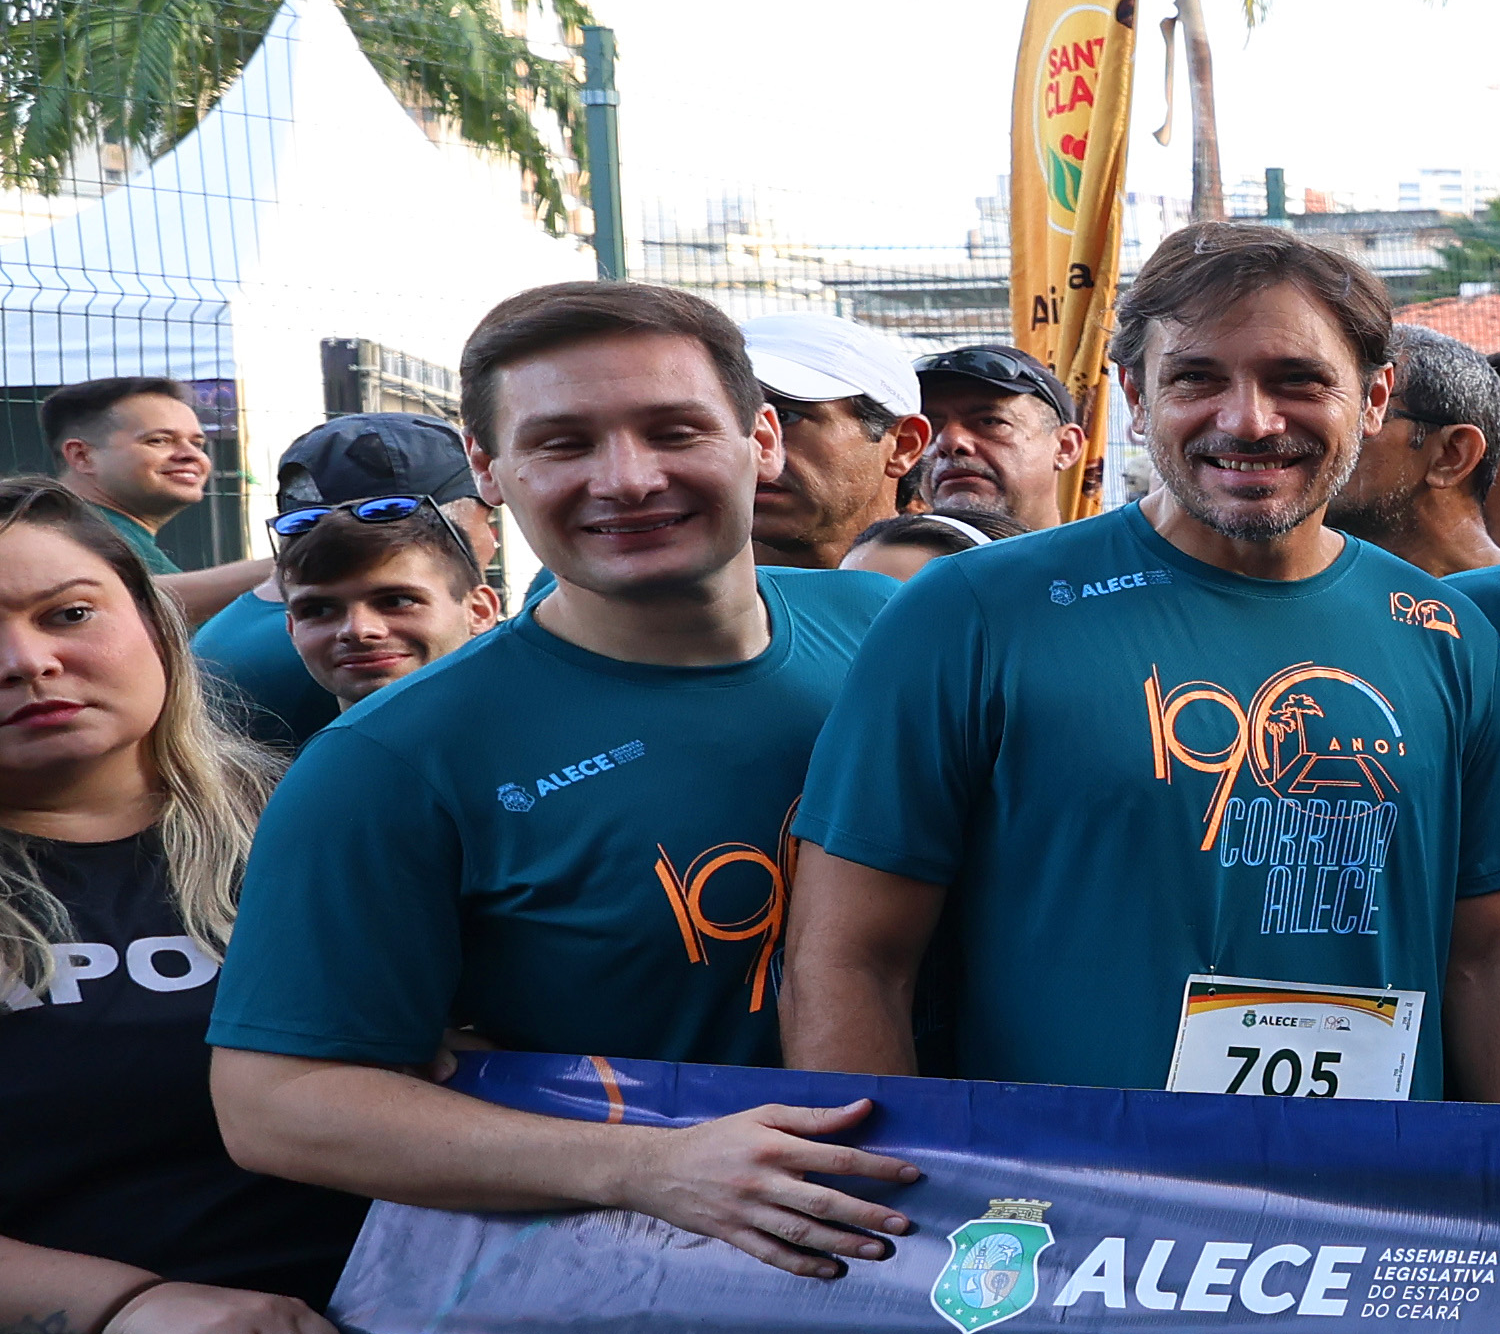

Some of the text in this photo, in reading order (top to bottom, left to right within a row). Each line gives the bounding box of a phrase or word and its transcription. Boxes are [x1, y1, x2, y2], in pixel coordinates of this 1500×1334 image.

[1081, 570, 1147, 599] ALECE
[1329, 736, 1405, 757] ANOS
[535, 752, 616, 798] ALECE
[1219, 797, 1399, 867] CORRIDA
[1260, 867, 1383, 935] ALECE
[1258, 1015, 1298, 1027] ALECE
[1225, 1046, 1342, 1098] 705
[1378, 1247, 1498, 1266] ASSEMBLEIA
[1053, 1236, 1367, 1317] ALECE
[1373, 1266, 1496, 1284] LEGISLATIVA
[1368, 1284, 1480, 1302] DO ESTADO
[1361, 1302, 1461, 1320] DO CEARÁ
